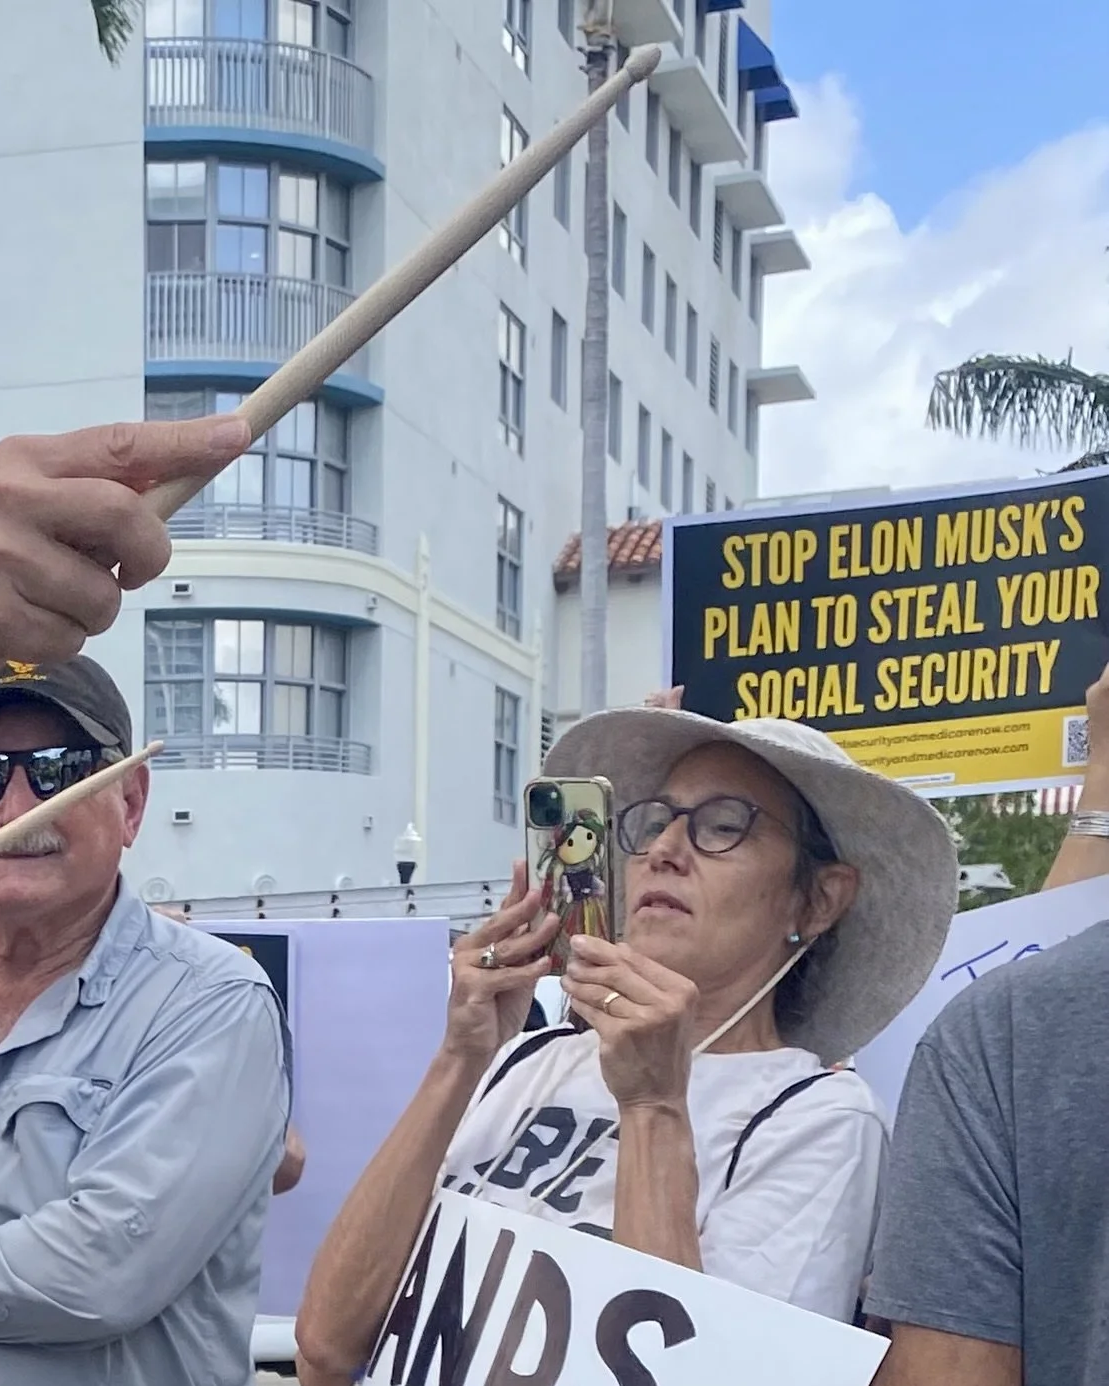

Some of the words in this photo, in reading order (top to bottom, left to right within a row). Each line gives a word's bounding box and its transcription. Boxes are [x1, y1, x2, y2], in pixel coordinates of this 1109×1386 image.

[721, 529, 818, 590] STOP
[829, 516, 923, 580] ELON
[934, 495, 1085, 567] MUSK'S
[703, 601, 801, 660] PLAN
[811, 594, 857, 650] TO
[867, 580, 985, 644] STEAL
[997, 564, 1100, 630] YOUR
[734, 662, 865, 722] SOCIAL
[874, 638, 1062, 712] SECURITY
